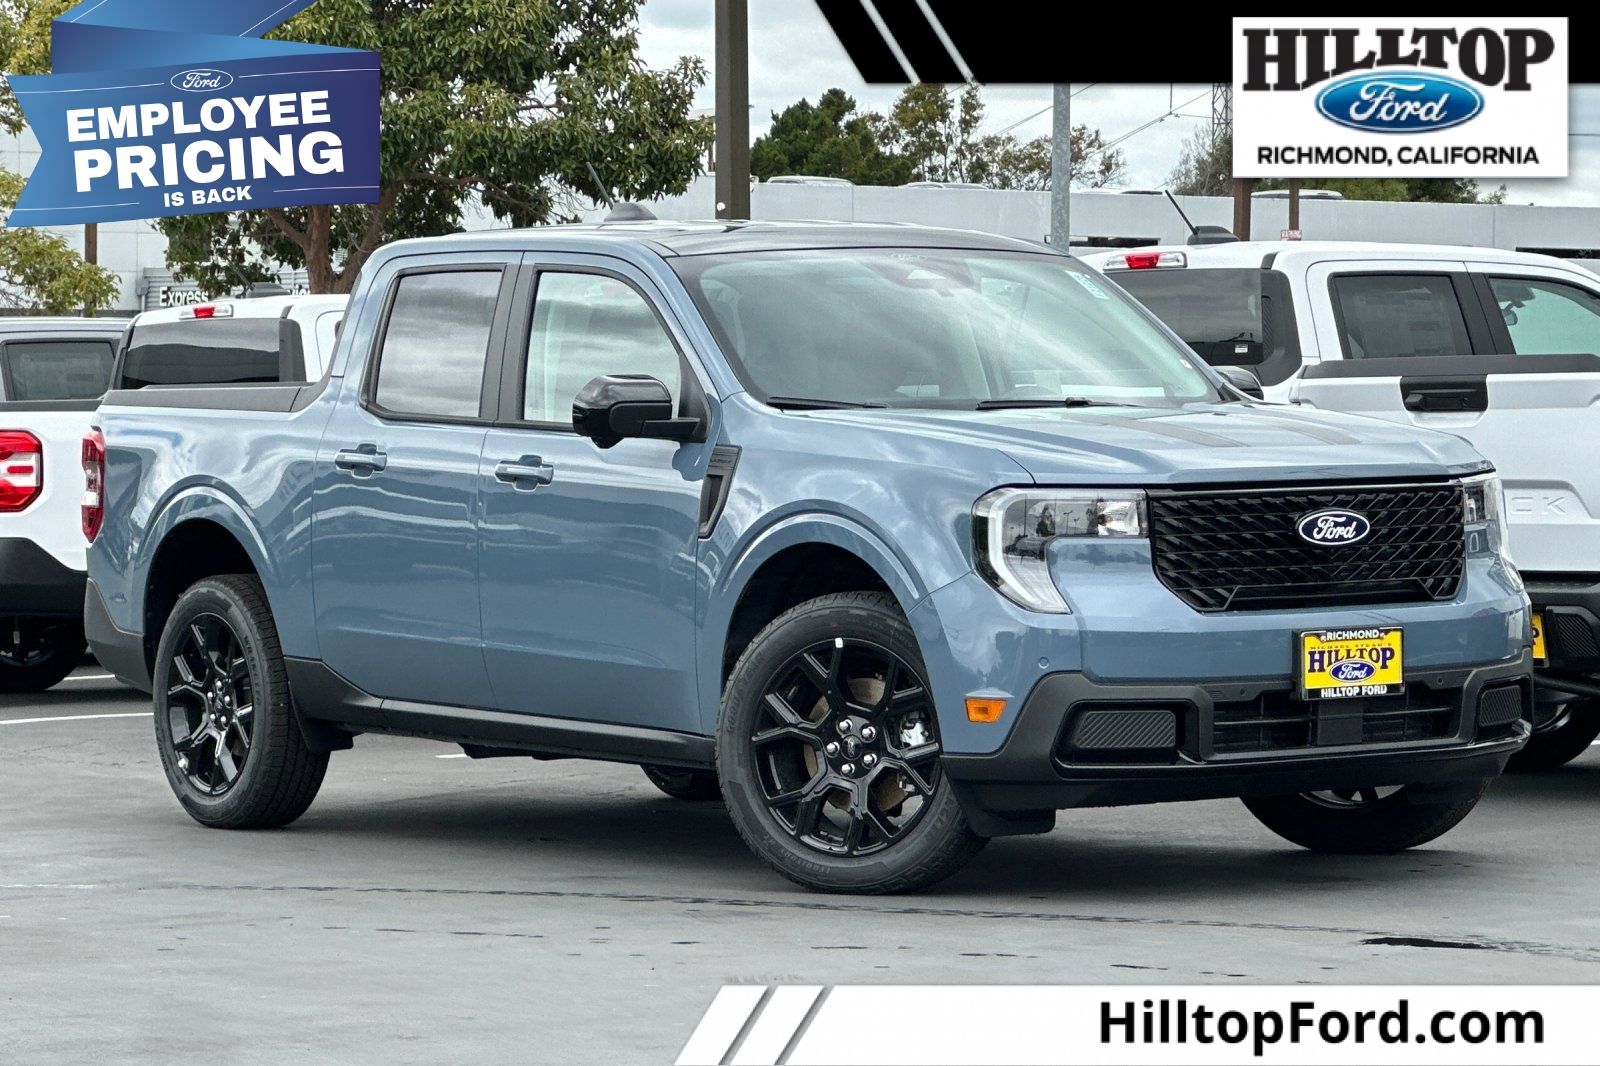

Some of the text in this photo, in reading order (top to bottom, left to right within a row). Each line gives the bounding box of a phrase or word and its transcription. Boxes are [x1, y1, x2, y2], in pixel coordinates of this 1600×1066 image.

[160, 286, 209, 307] Express
[1313, 516, 1357, 540] Ford
[1326, 629, 1380, 641] RICHMOND
[1308, 647, 1395, 673] HILLTOP
[1339, 663, 1367, 679] Ford
[1321, 685, 1388, 698] HILLTOP FORD
